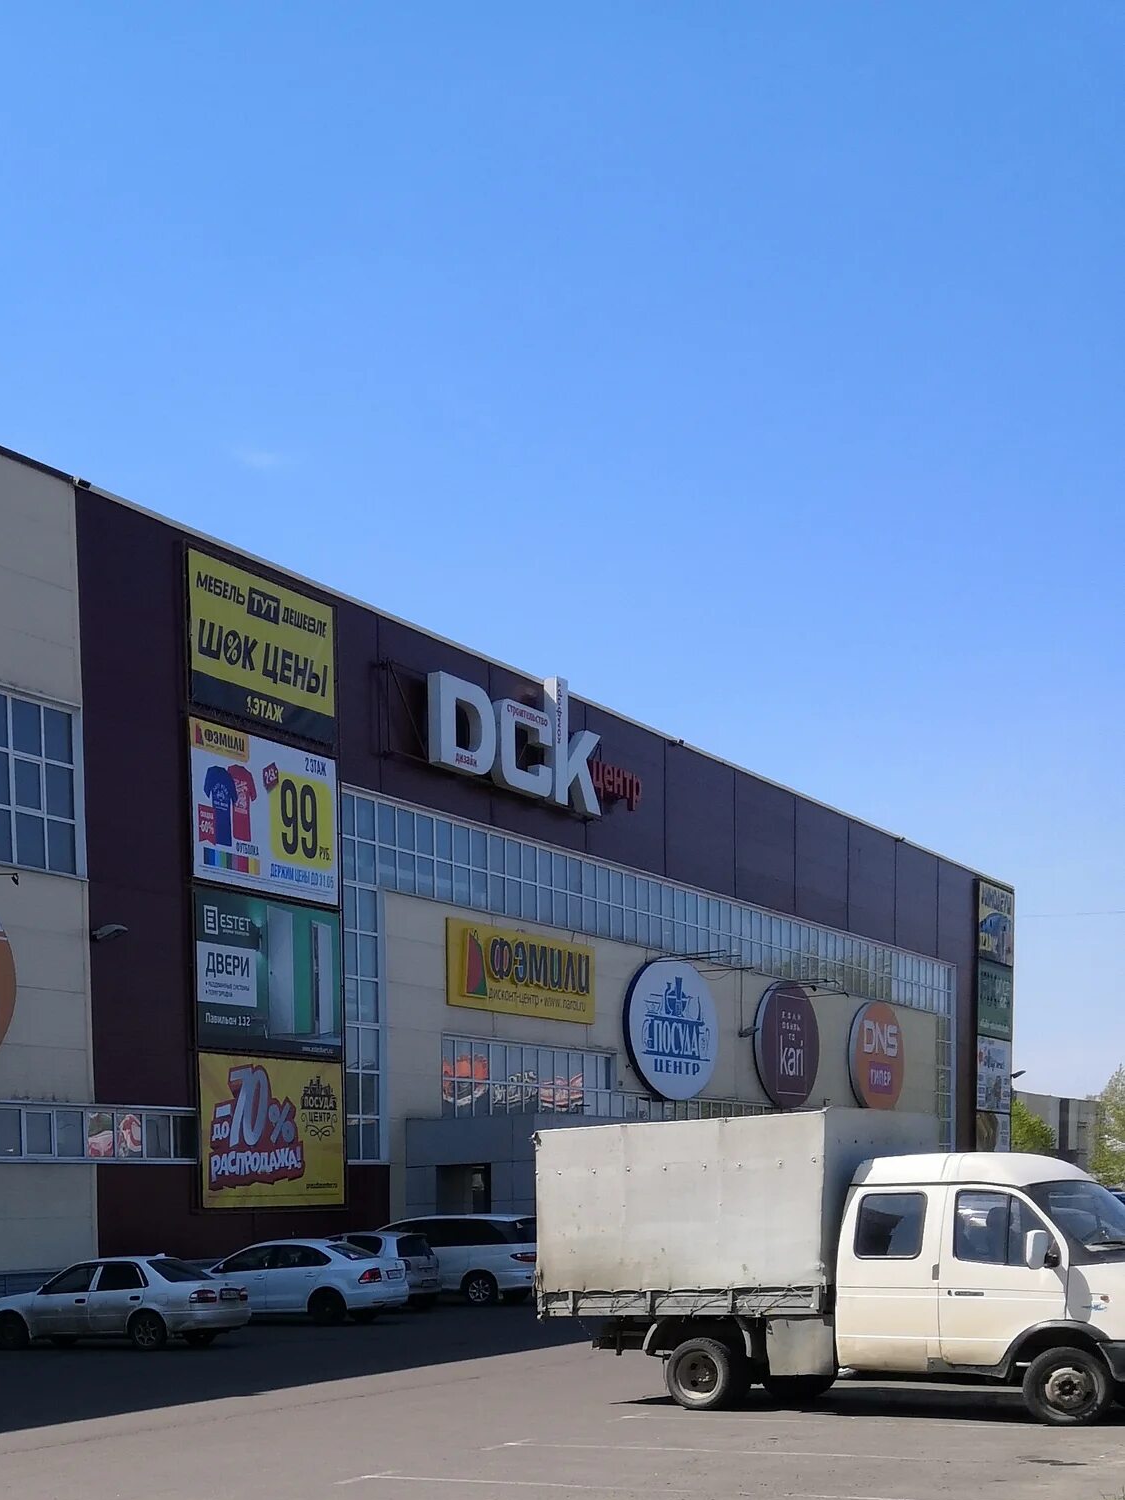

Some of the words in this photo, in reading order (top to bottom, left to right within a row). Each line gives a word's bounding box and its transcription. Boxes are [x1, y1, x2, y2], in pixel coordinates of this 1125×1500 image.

[196, 570, 246, 606] МЕБЕЛЬ
[251, 593, 279, 619] ТУТ
[281, 606, 327, 639] ДЕШЕВЛЕ
[262, 641, 328, 698] ЦЕНЫ
[591, 759, 642, 812] центр
[280, 778, 318, 859] 99
[220, 913, 251, 931] ESTET
[205, 951, 250, 979] ДВЕРИ
[238, 1015, 251, 1027] 132
[653, 1019, 700, 1057] ПОСУДА
[863, 1019, 899, 1057] DNS
[653, 1058, 701, 1076] ЦЕНТР
[779, 1034, 804, 1077] kari
[303, 1095, 335, 1110] ПОСУДА
[308, 1112, 332, 1123] ЦЕНТР
[210, 1145, 302, 1183] РАСПРОДАЖА!
